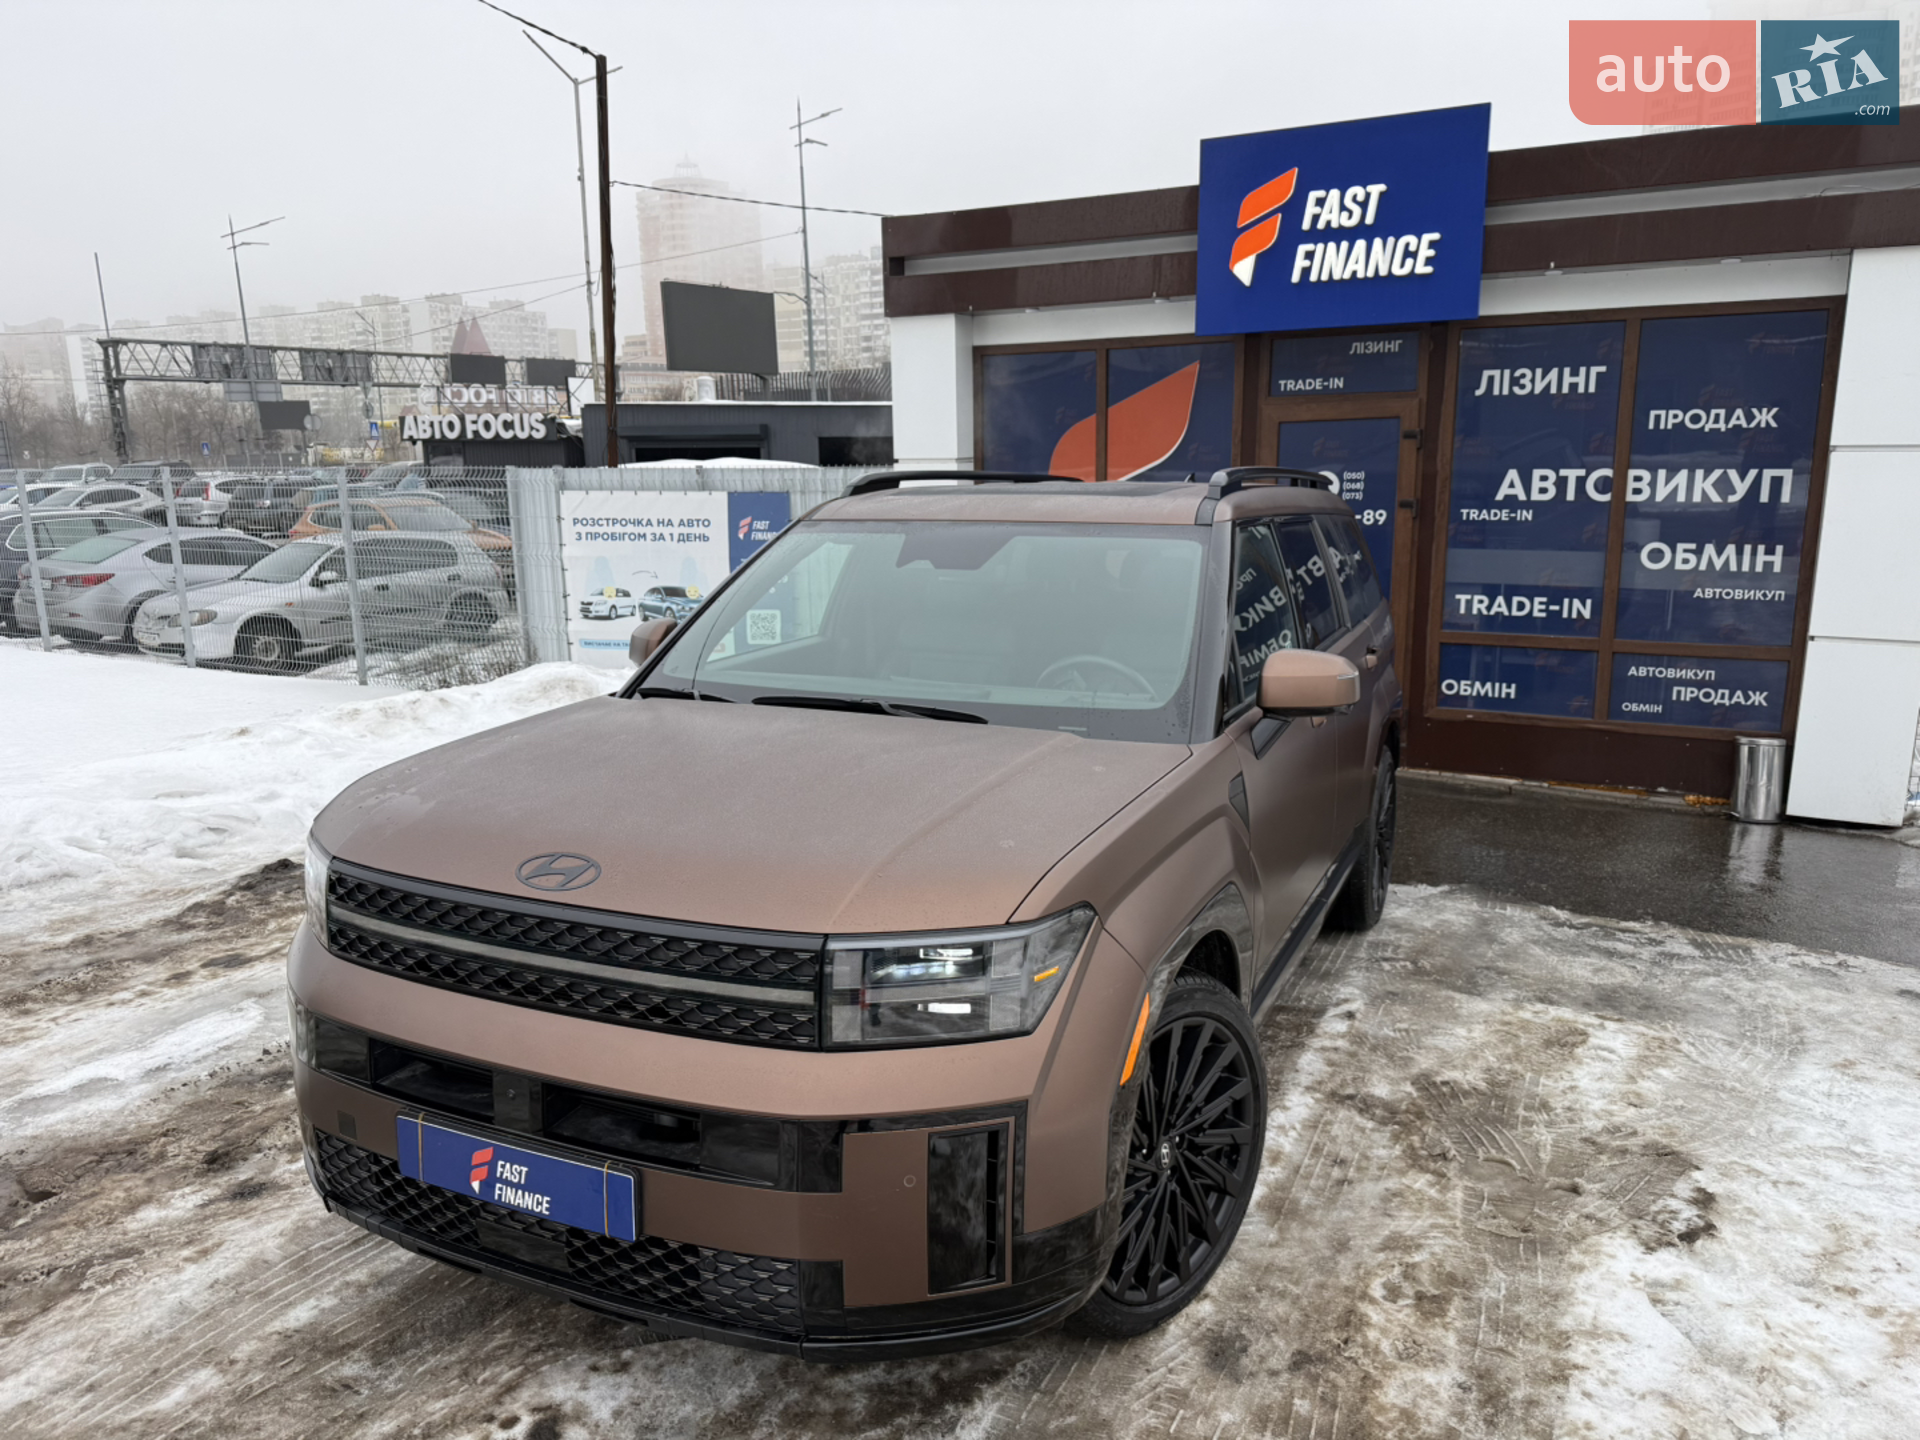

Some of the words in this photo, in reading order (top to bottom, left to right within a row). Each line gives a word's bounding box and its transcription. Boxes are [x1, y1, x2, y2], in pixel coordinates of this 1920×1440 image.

[1301, 184, 1388, 231] FAST
[1291, 232, 1441, 284] FINANCE
[1349, 339, 1403, 355] ЛІЗИНГ
[1278, 376, 1344, 392] TRADE-IN
[1474, 365, 1607, 397] ЛІЗИНГ
[402, 413, 461, 440] АВТО
[464, 412, 547, 440] FOCUS
[1648, 407, 1779, 433] ПРОДАЖ
[1343, 471, 1365, 481] (050)
[1494, 467, 1794, 504] АВТОВИКУП
[572, 517, 654, 528] РОЗСТРОЧКА
[656, 518, 675, 528] НА
[677, 518, 711, 528] АВТО
[752, 520, 770, 530] FAST
[1460, 508, 1533, 521] TRADE-IN
[585, 532, 647, 542] ПРОБІГОМ
[650, 533, 667, 542] ЗА
[669, 533, 674, 541] 1
[676, 533, 710, 543] ДЕНЬ
[1639, 541, 1784, 573] ОБМІН
[1692, 587, 1786, 601] АВТОВИКУП
[1454, 594, 1592, 620] TRADE-IN
[1627, 665, 1716, 681] АВТОВИКУП
[1441, 678, 1516, 700] ОБМІН
[1671, 686, 1769, 707] ПРОДАЖ
[1621, 701, 1663, 714] ОБМІН
[496, 1161, 528, 1184] FAST
[495, 1183, 551, 1215] FINANCE
